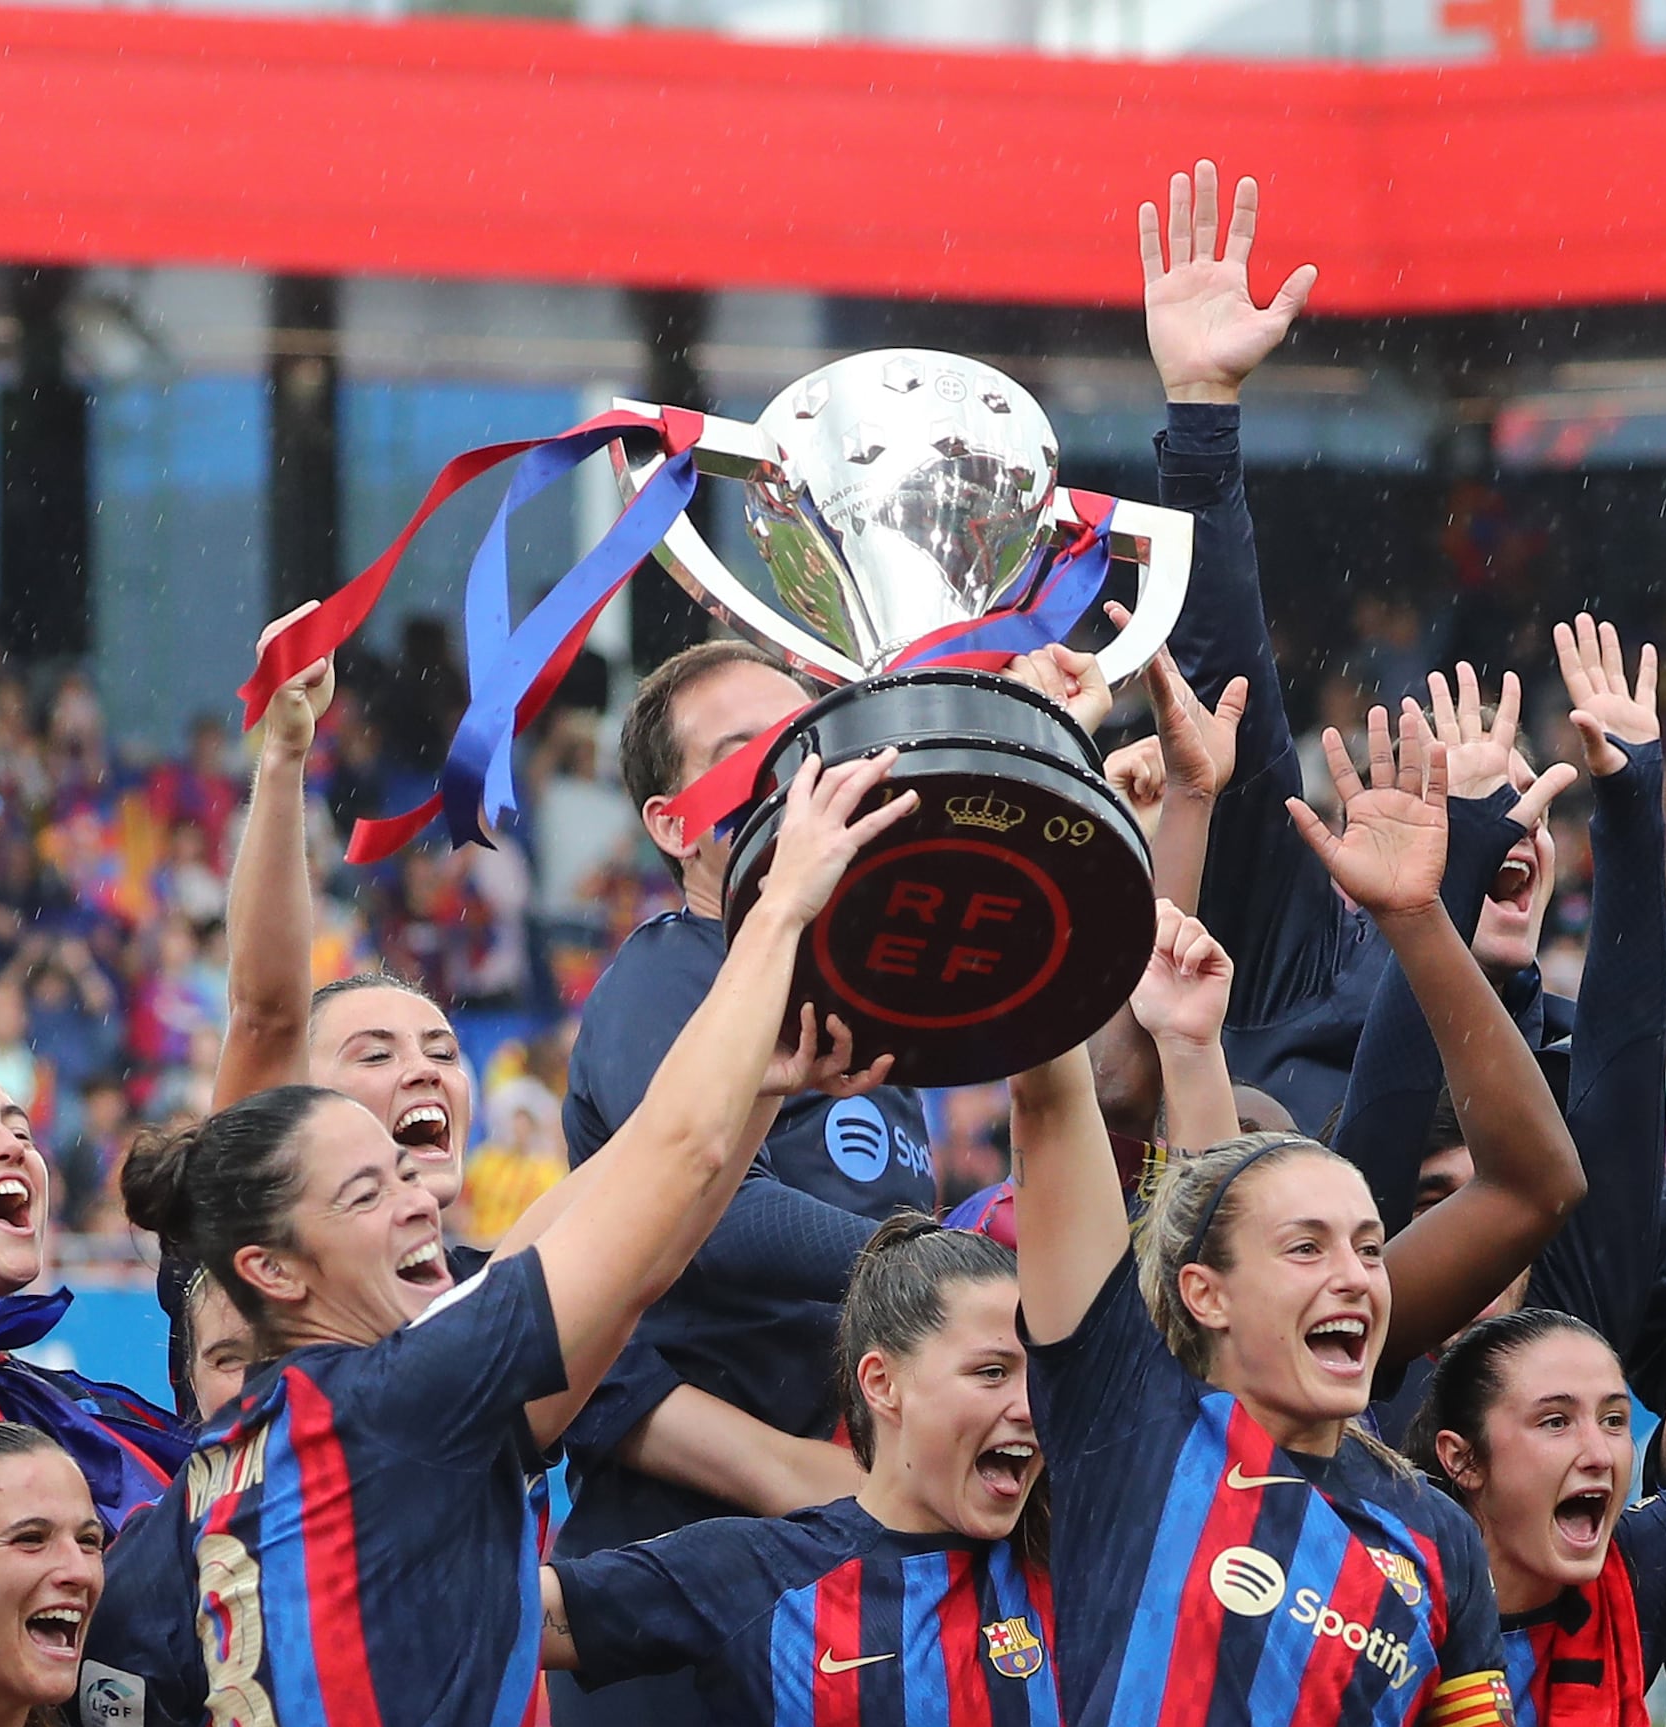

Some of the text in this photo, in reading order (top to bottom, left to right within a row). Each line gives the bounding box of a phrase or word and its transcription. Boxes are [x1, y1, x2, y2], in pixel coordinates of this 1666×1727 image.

[1043, 815, 1095, 847] 09
[1290, 1588, 1420, 1691] Spotify
[92, 1698, 132, 1718] Liga F
